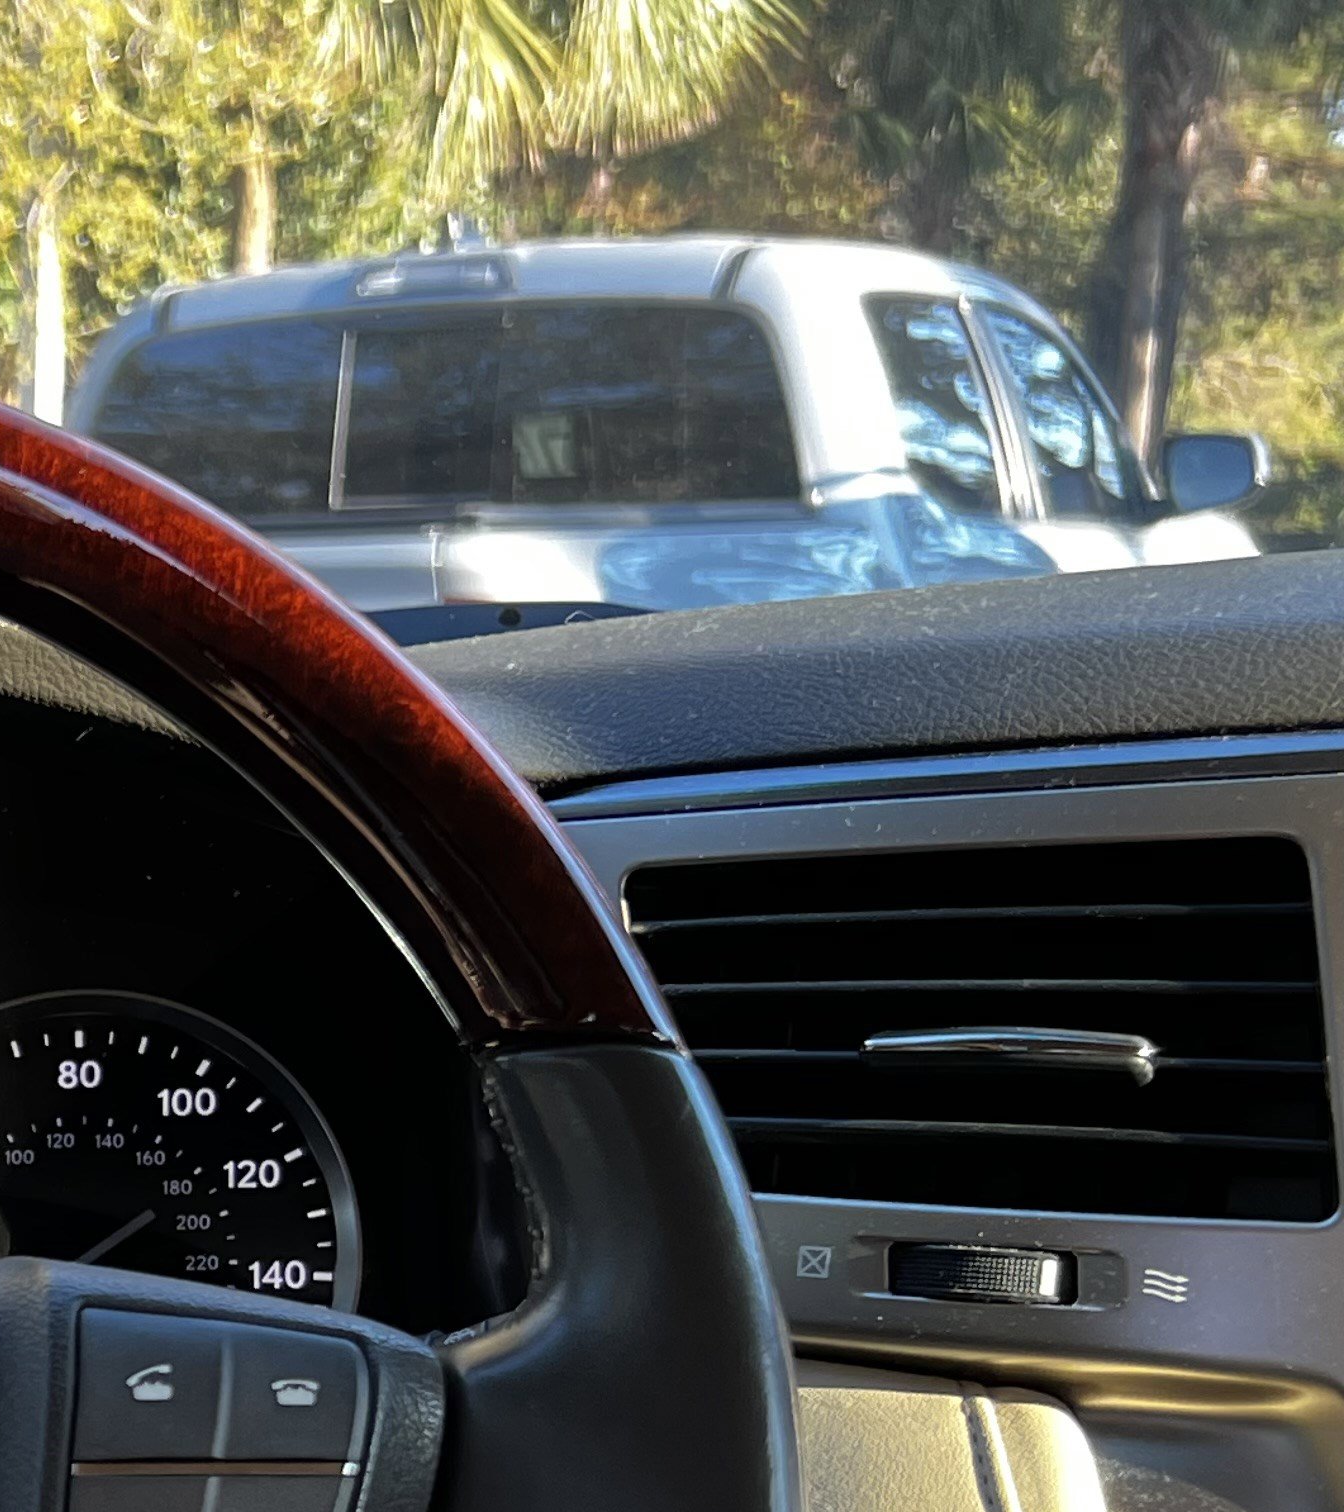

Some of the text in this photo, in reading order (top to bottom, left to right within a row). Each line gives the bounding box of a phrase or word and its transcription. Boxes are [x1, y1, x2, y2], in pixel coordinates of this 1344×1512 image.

[57, 1060, 101, 1089] 80
[157, 1088, 217, 1117] 100
[46, 1133, 75, 1149] 120
[95, 1133, 125, 1149] 140
[5, 1150, 35, 1166] 100
[135, 1150, 166, 1166] 160
[223, 1160, 281, 1190] 120
[162, 1179, 193, 1196] 180
[175, 1214, 212, 1231] 200
[185, 1255, 219, 1272] 220
[248, 1260, 307, 1290] 140
